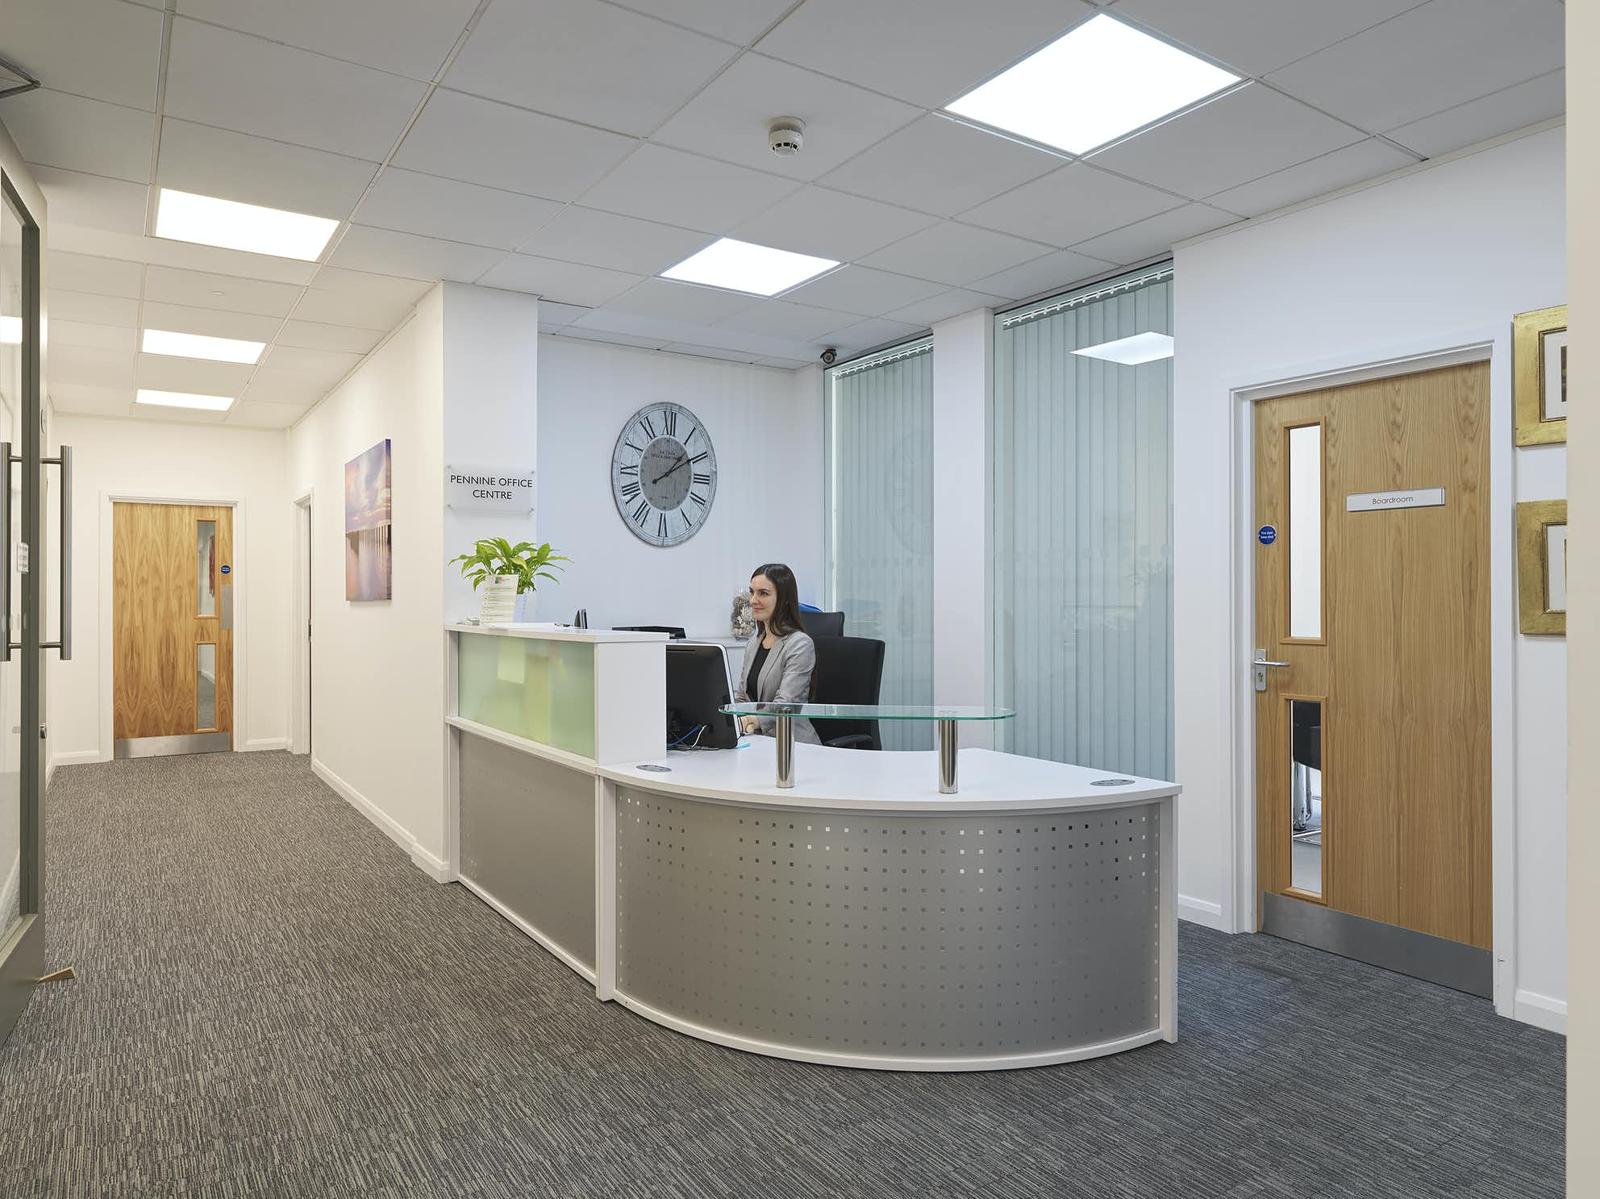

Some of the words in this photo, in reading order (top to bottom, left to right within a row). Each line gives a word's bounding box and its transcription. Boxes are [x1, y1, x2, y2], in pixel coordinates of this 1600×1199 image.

[450, 474, 496, 486] PENNINE
[498, 477, 533, 488] OFFICE
[472, 489, 513, 500] CENTRE
[1372, 496, 1414, 505] Boardroom
